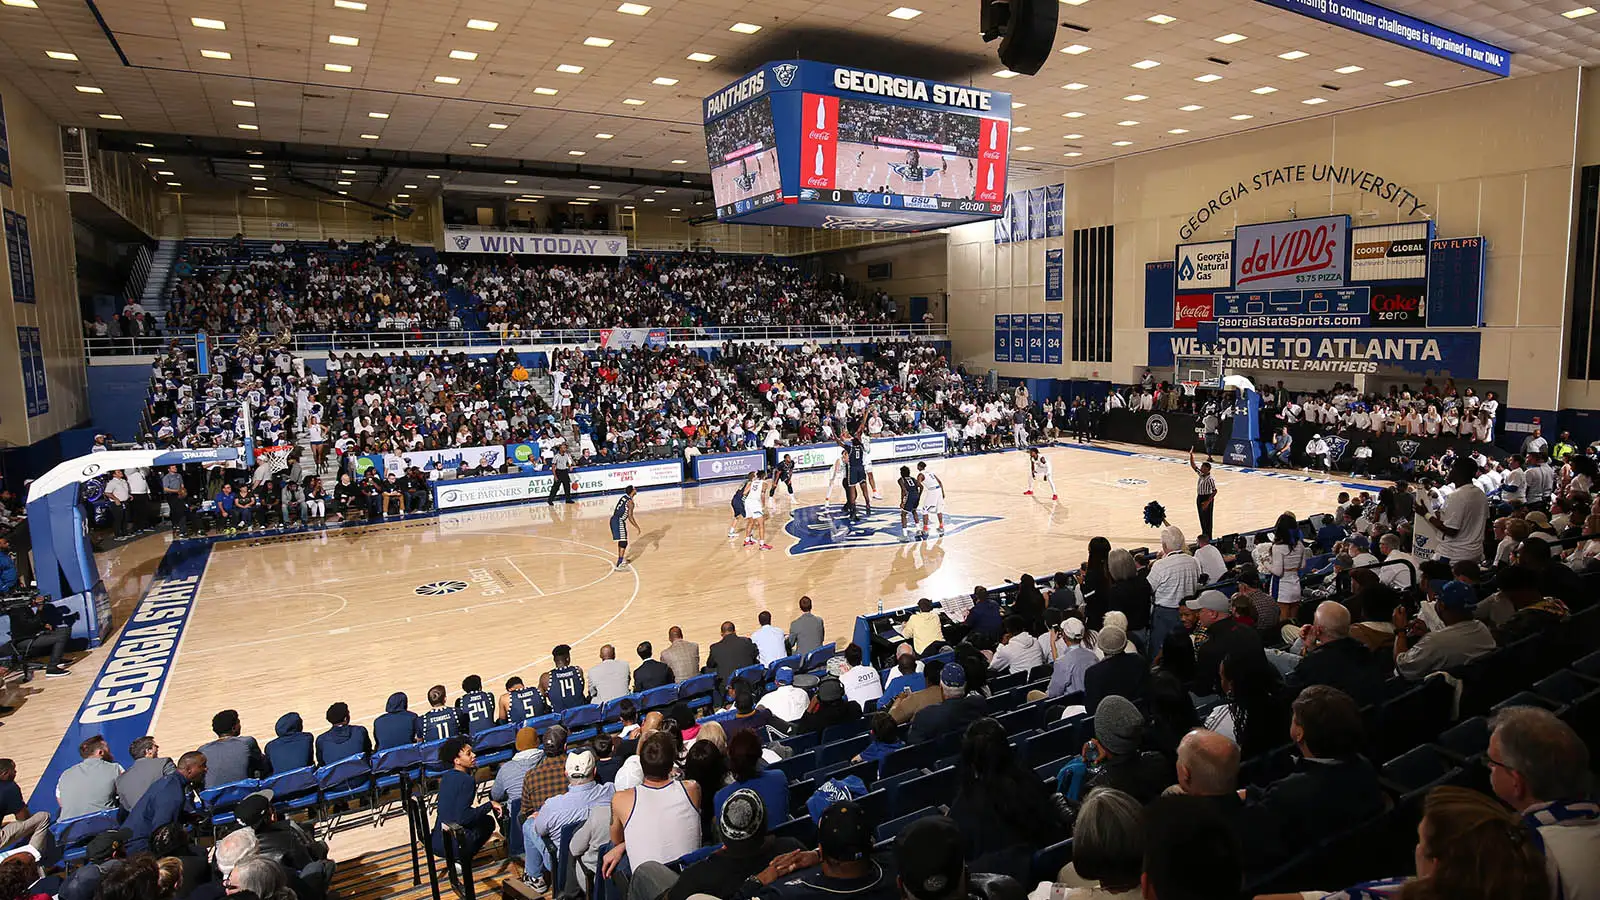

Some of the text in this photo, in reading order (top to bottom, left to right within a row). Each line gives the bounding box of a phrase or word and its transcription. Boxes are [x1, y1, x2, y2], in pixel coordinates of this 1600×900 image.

[1328, 1, 1339, 15] to
[1340, 5, 1377, 26] conquer
[1377, 16, 1421, 41] challenges
[1422, 29, 1430, 44] is
[1430, 32, 1464, 55] ingrained
[1465, 43, 1472, 58] in
[1472, 49, 1485, 61] our
[707, 71, 765, 119] PANTHERS
[834, 68, 992, 111] GEORGIA STATE
[832, 190, 841, 202] 0
[883, 195, 891, 206] 0
[959, 202, 985, 211] 20:00
[991, 204, 1001, 212] 30
[1179, 164, 1427, 240] GEORGIA STATE UNIVERSITY
[480, 236, 598, 254] WIN TODAY
[1392, 244, 1424, 252] GLOBAL
[1433, 241, 1447, 250] PLY
[1462, 239, 1478, 247] PTS
[1197, 251, 1230, 262] Georgia
[1356, 247, 1385, 255] COOPER
[1196, 261, 1228, 271] Natural
[1196, 271, 1212, 280] Gas
[1295, 273, 1342, 283] $3.75 PIZZA
[1371, 294, 1417, 311] Coke
[1378, 311, 1408, 320] zero
[1217, 316, 1361, 328] GeorgiaStateSports.com
[999, 338, 1006, 347] 3
[1014, 338, 1024, 347] 51
[1030, 338, 1042, 348] 24
[1048, 338, 1060, 348] 34
[1280, 338, 1311, 357] TO
[1317, 338, 1442, 361] ATLANTA
[1262, 359, 1300, 370] STATE
[1303, 360, 1378, 373] PANTHERS
[182, 450, 218, 459] SPALDING
[613, 470, 638, 478] TRINITY
[528, 478, 553, 487] ATLA
[460, 492, 475, 502] EYE
[478, 486, 523, 500] PARTNERS
[79, 575, 199, 724] GEORGIA STATE
[857, 672, 874, 682] 2017
[559, 677, 576, 698] 14
[468, 701, 489, 722] 24
[522, 698, 535, 718] 5
[436, 722, 450, 740] 11
